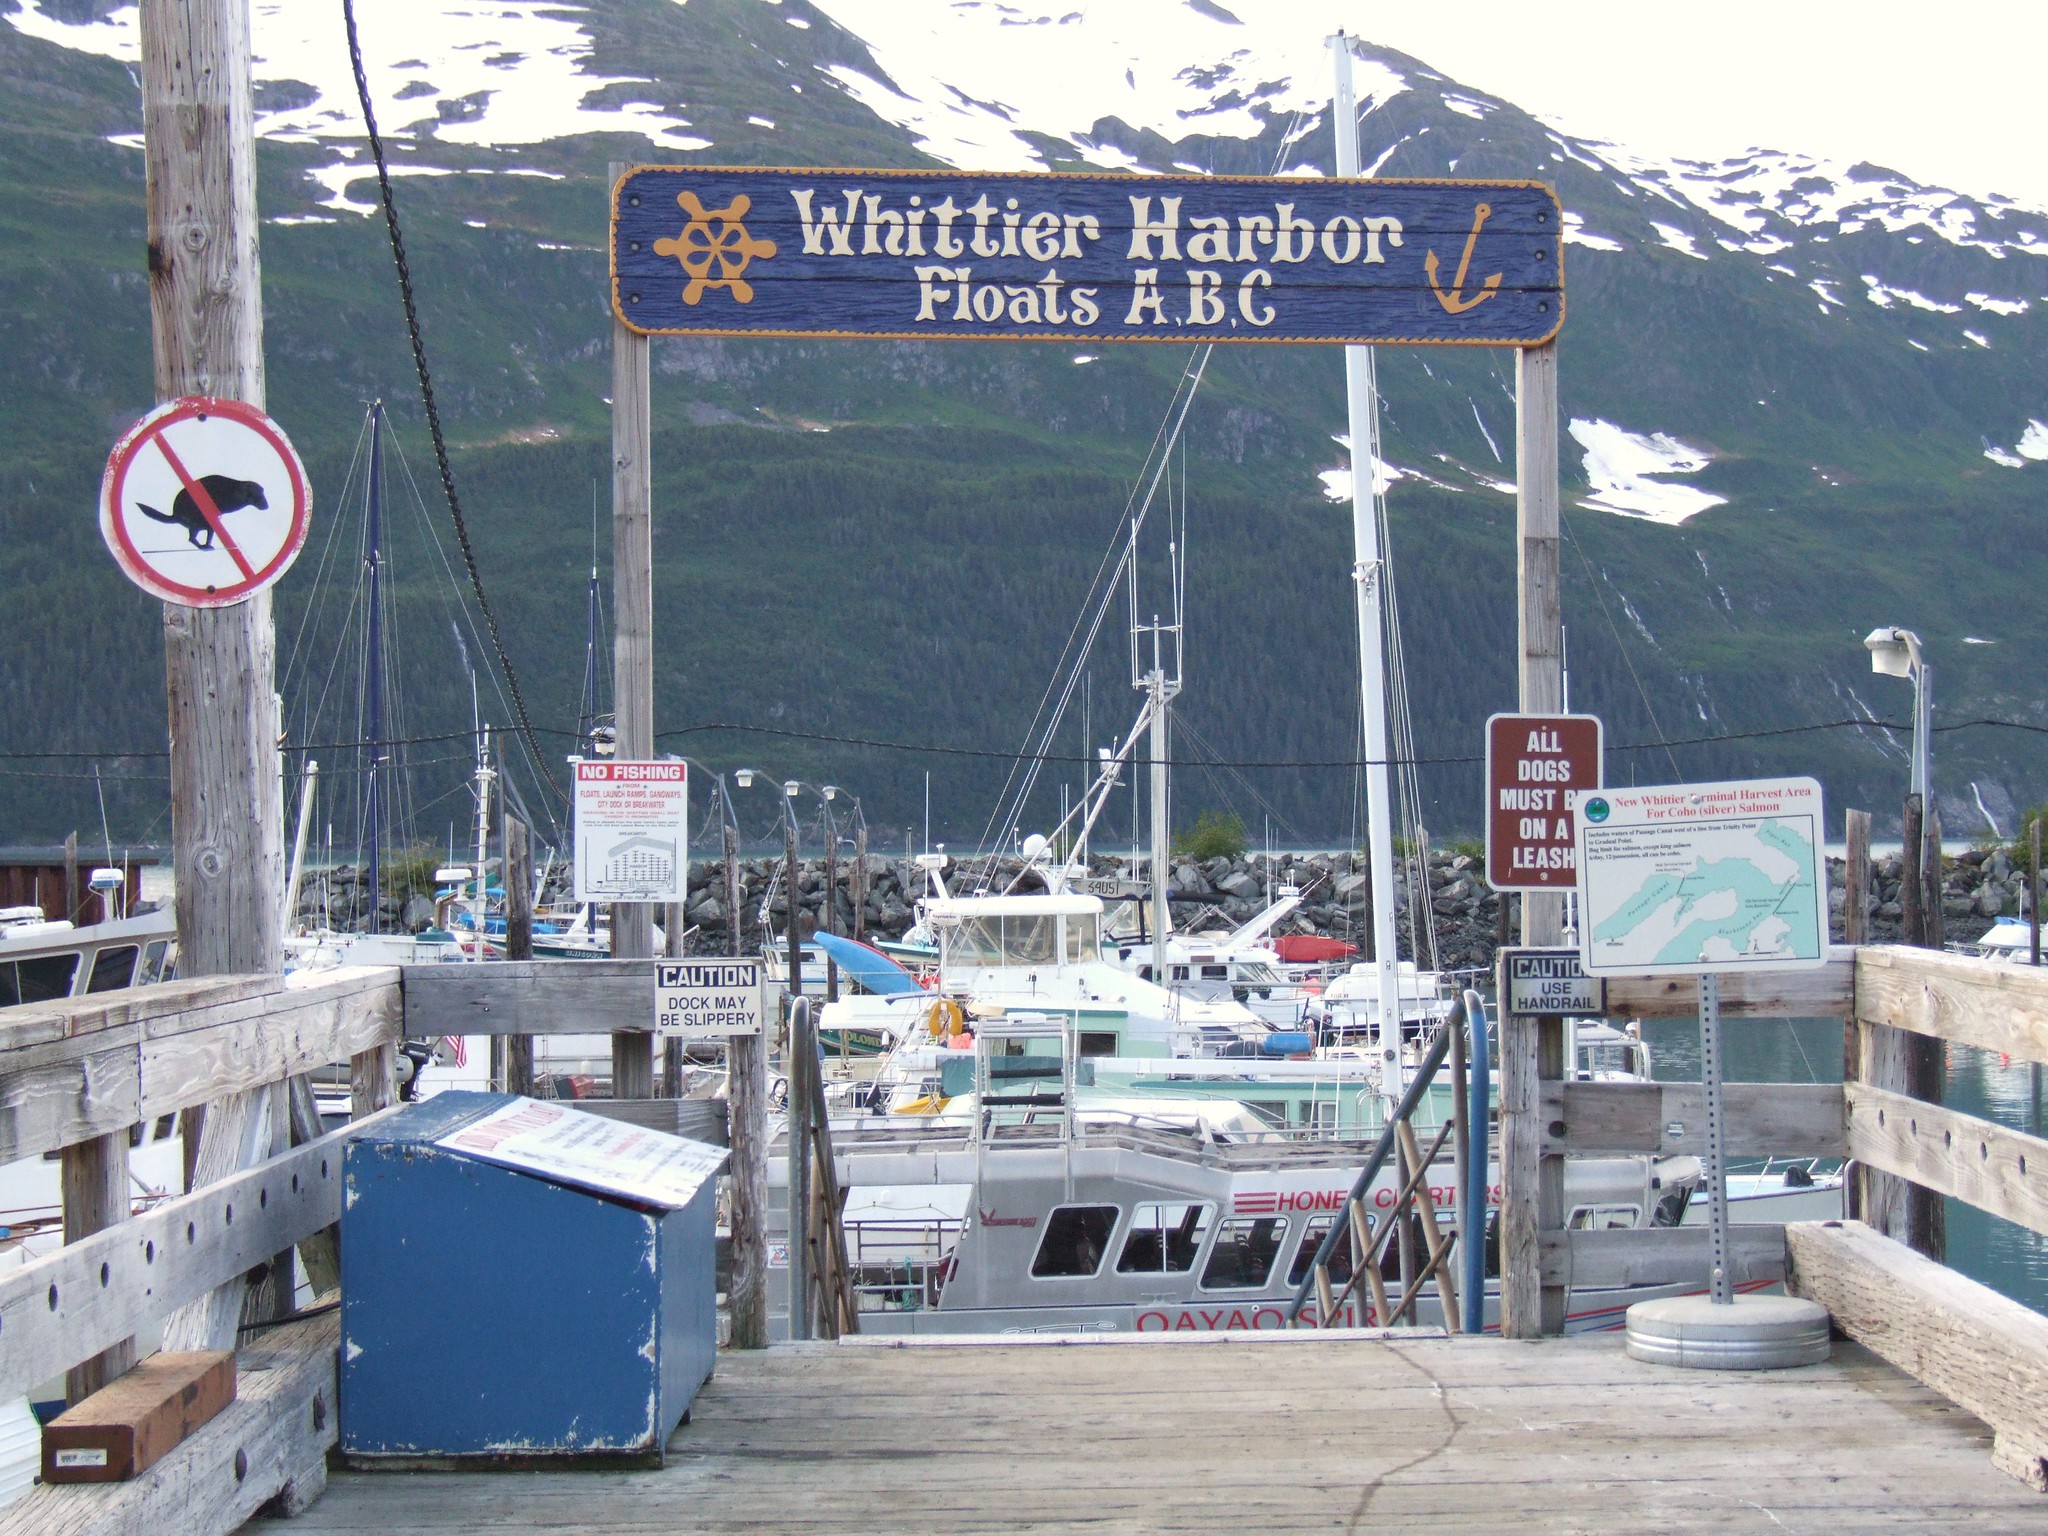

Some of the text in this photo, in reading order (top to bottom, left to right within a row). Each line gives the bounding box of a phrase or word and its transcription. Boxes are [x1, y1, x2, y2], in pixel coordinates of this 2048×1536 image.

[790, 188, 1404, 264] Whittier Harbor
[914, 266, 1099, 326] Floats
[1527, 731, 1562, 752] ALL
[582, 766, 681, 779] NO FISHING
[1518, 760, 1570, 782] DOGS
[603, 790, 625, 798] LAUNCH
[1500, 789, 1578, 810] MUST B
[1615, 797, 1638, 807] New
[1641, 794, 1685, 805] Whittier
[1740, 788, 1782, 799] Harvest
[1785, 787, 1811, 797] Area
[1647, 802, 1780, 819] For Coho (silver) Salmon
[1520, 818, 1569, 840] ON A
[1513, 847, 1576, 869] LEASH
[663, 967, 753, 986] CAUTION
[1517, 959, 1587, 977] CAUTIO
[1541, 982, 1572, 994] USE
[669, 996, 747, 1009] DOCK MAY
[1518, 997, 1595, 1009] HANDRAIL
[661, 1012, 755, 1026] BE SLIPPERY
